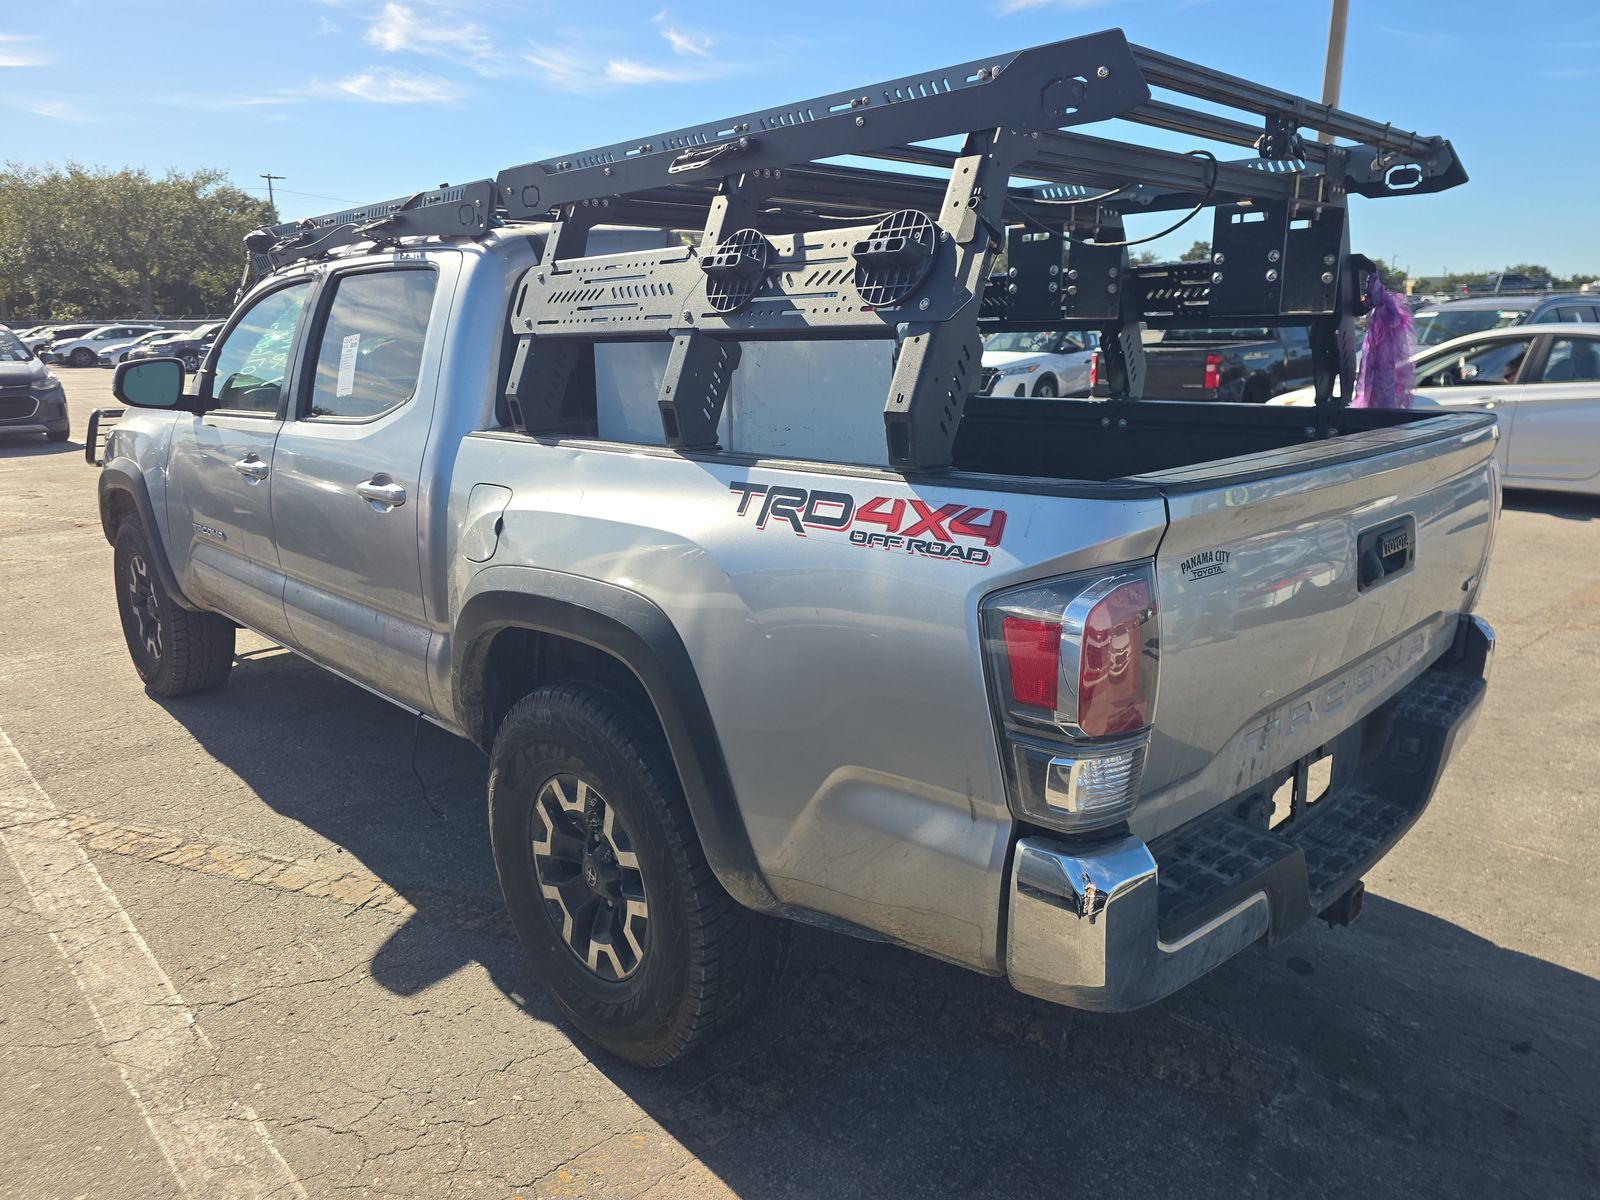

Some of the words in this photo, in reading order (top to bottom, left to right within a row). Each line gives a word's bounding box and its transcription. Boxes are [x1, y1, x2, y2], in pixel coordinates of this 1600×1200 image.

[729, 481, 856, 537] TRD
[855, 496, 1007, 548] 4X4
[849, 530, 905, 551] OFF
[906, 538, 991, 567] ROAD
[1181, 551, 1214, 575] PANAMA
[1215, 550, 1231, 563] CITY
[1192, 566, 1222, 578] TOYOTA
[1243, 632, 1426, 752] TACOMA
